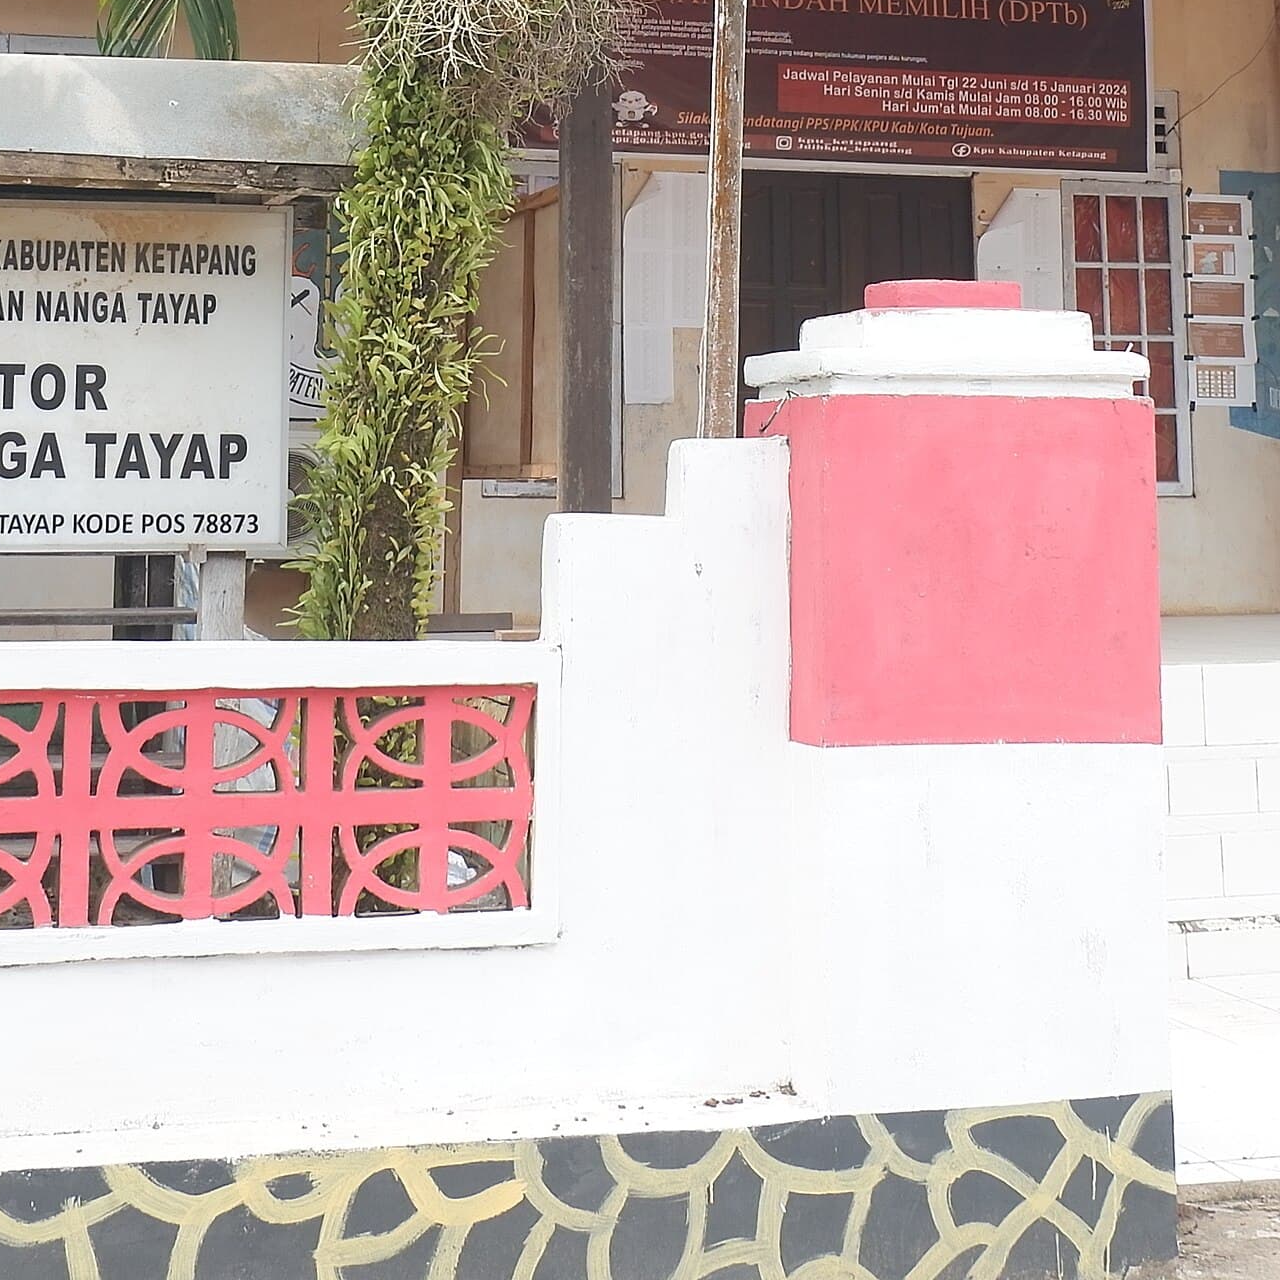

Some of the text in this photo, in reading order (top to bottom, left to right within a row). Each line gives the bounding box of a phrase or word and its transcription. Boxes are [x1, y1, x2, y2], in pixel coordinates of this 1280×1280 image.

[999, 0, 1088, 31] (DPTb)
[783, 68, 1127, 95] Jadwal Pelayanan Mulai Tgl 22 Juni s/d 15 Januari 2024
[823, 84, 851, 96] Hari
[854, 85, 890, 98] Senin
[894, 88, 912, 99] s/d
[916, 90, 955, 101] Kamis
[959, 91, 992, 103] Mulai
[995, 93, 1021, 104] Jam
[1024, 94, 1058, 106] 08.00
[1070, 97, 1102, 108] 16.00
[1105, 98, 1127, 109] Wib
[882, 100, 908, 112] Hari
[912, 102, 955, 114] Jum'at
[959, 104, 992, 116] Mulai
[995, 106, 1021, 117] Jam
[1024, 107, 1058, 119] 08.00
[1070, 109, 1102, 121] 16.30
[1105, 111, 1127, 122] Wib
[677, 111, 994, 139] Silak endatangi PPS/PPK/KPU Kab/Kota Tujuan.
[973, 146, 1106, 160] Kpu Kabupaten Ketapang
[136, 243, 256, 275] KETAPANG
[36, 291, 127, 323] NANGA
[138, 293, 217, 325] TAYAP
[85, 432, 248, 480] TAYAP
[72, 513, 133, 535] KODE
[141, 513, 185, 535] POS
[192, 513, 259, 535] 78873
